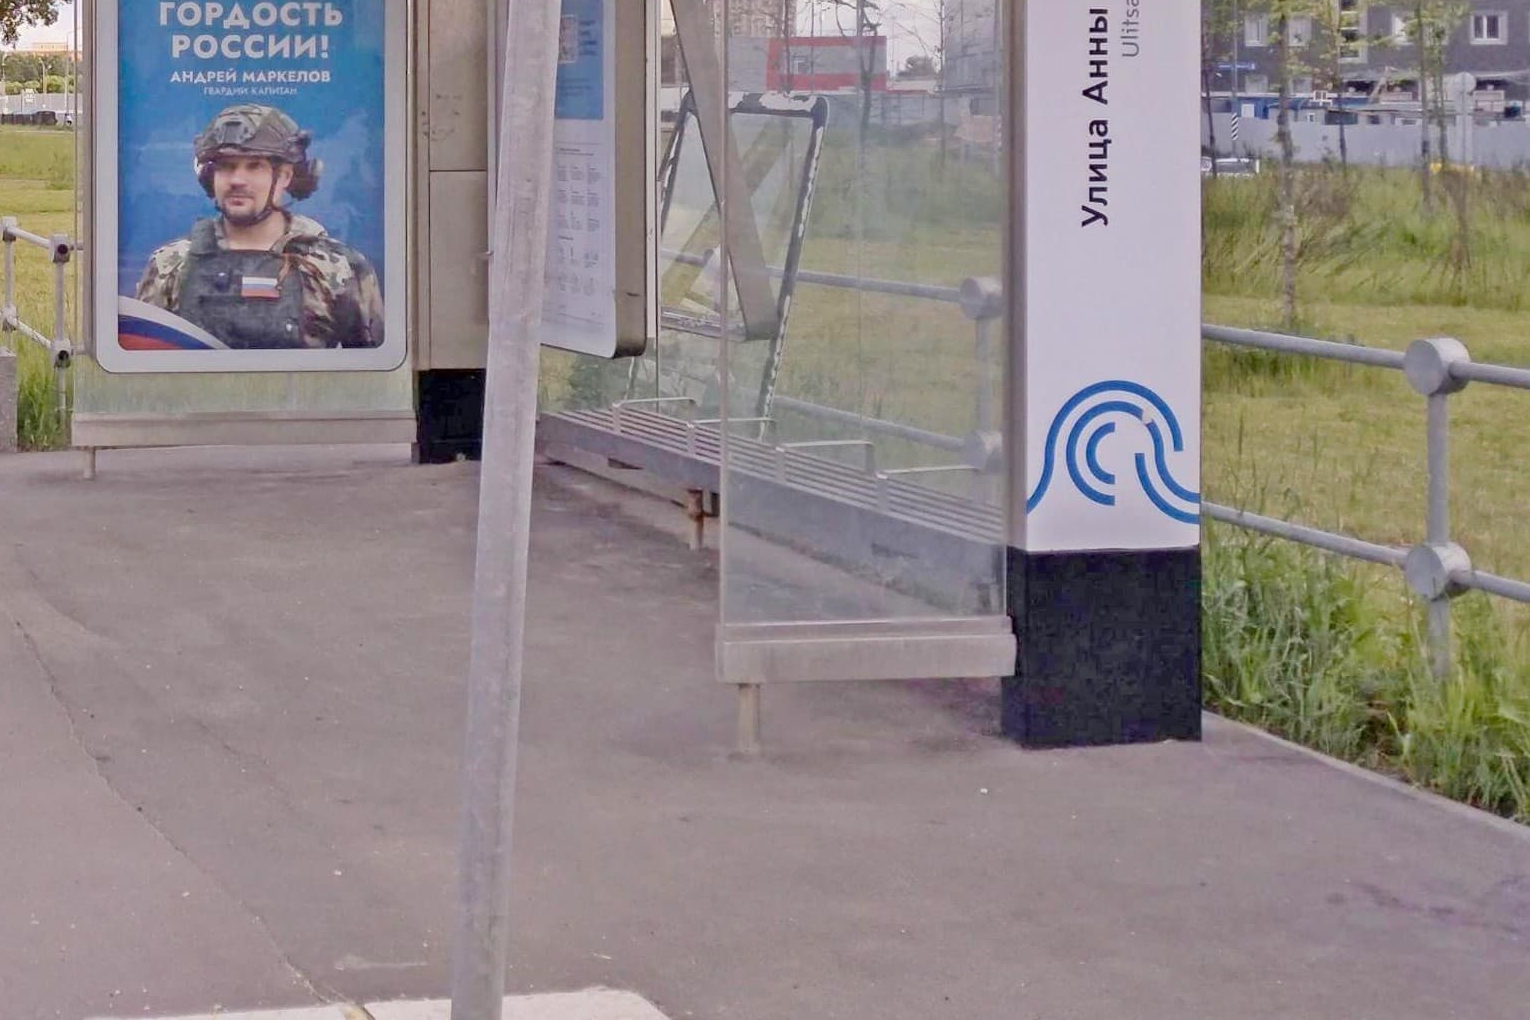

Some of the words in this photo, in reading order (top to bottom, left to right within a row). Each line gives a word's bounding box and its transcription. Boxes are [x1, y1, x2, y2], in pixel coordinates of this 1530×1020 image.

[159, 1, 343, 29] ГОРДОСТЬ
[172, 34, 329, 59] РОССИИ!
[1082, 8, 1108, 105] Анны
[170, 68, 237, 84] АНДРЕЙ
[242, 70, 331, 83] МАРКЕЛОВ
[203, 86, 248, 96] ГВАРДИИ
[251, 86, 298, 96] КАПИТАН
[1081, 119, 1112, 227] Улица
